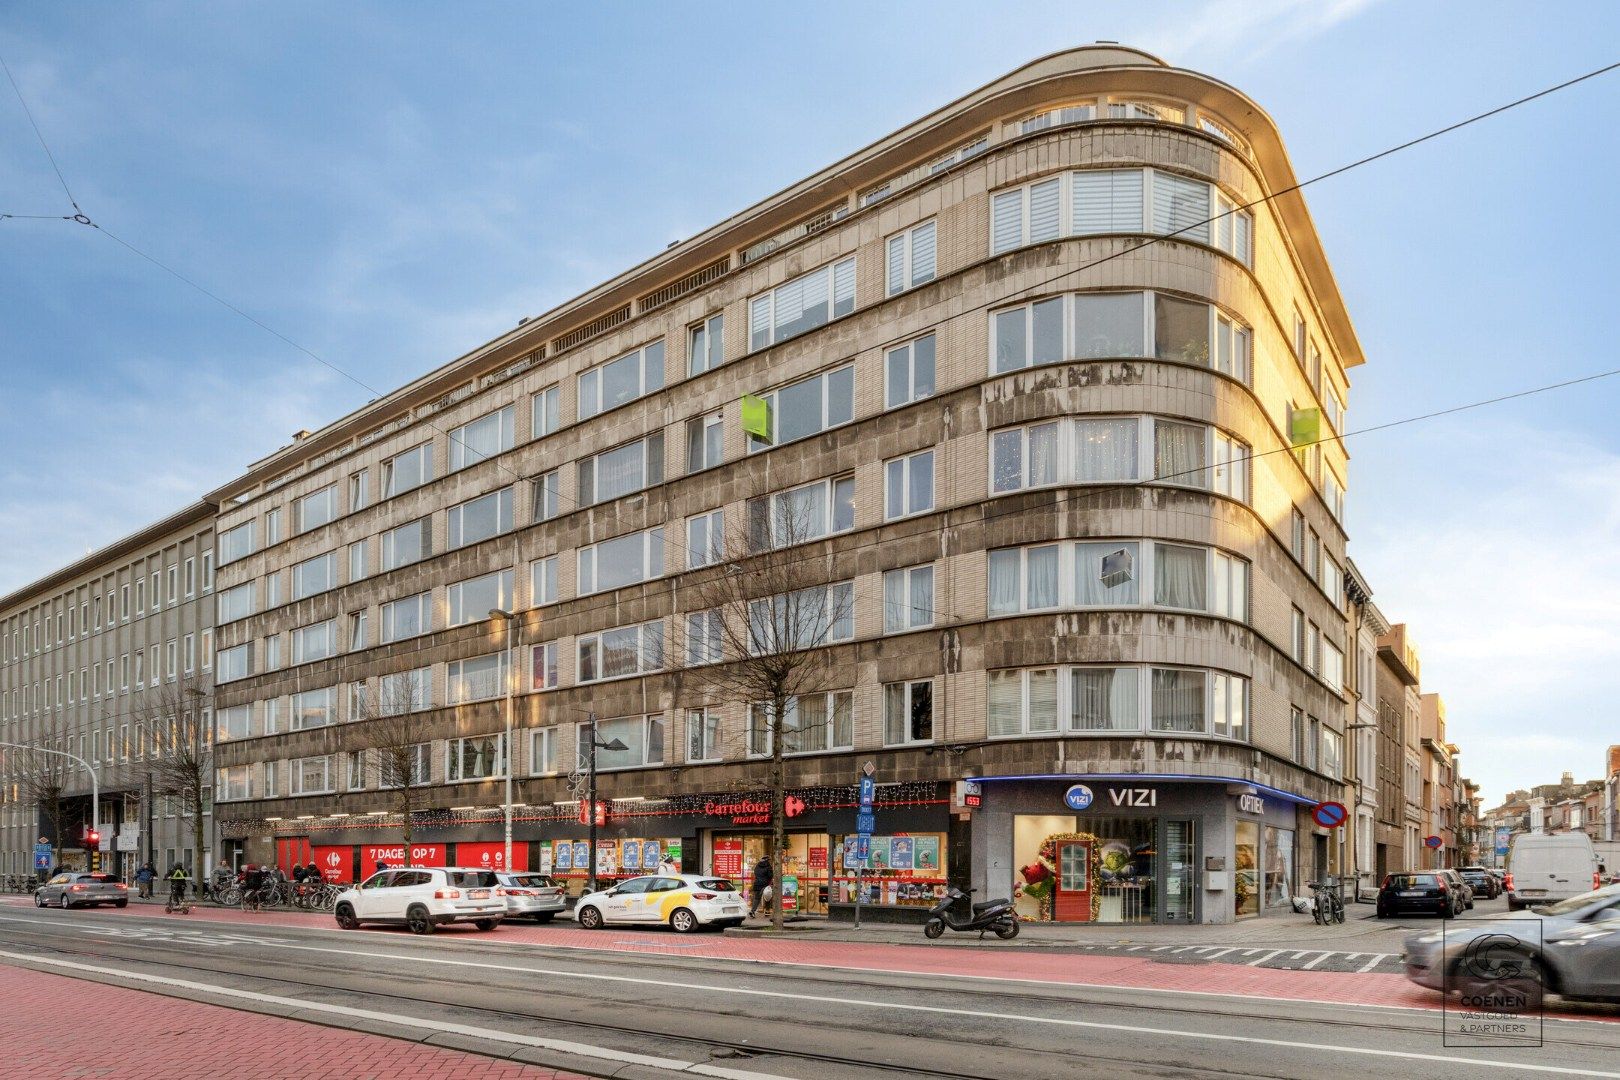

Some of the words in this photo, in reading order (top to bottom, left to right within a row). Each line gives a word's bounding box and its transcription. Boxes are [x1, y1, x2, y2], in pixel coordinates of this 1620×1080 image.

[863, 779, 871, 794] P
[1069, 795, 1089, 803] VIZI
[1109, 788, 1156, 807] VIZI
[1240, 794, 1265, 815] OPTIEK
[705, 799, 771, 815] Carrefour
[732, 813, 770, 824] market
[370, 848, 376, 859] 7
[377, 848, 405, 859] DAGE
[412, 847, 427, 859] OP
[429, 847, 436, 859] 7
